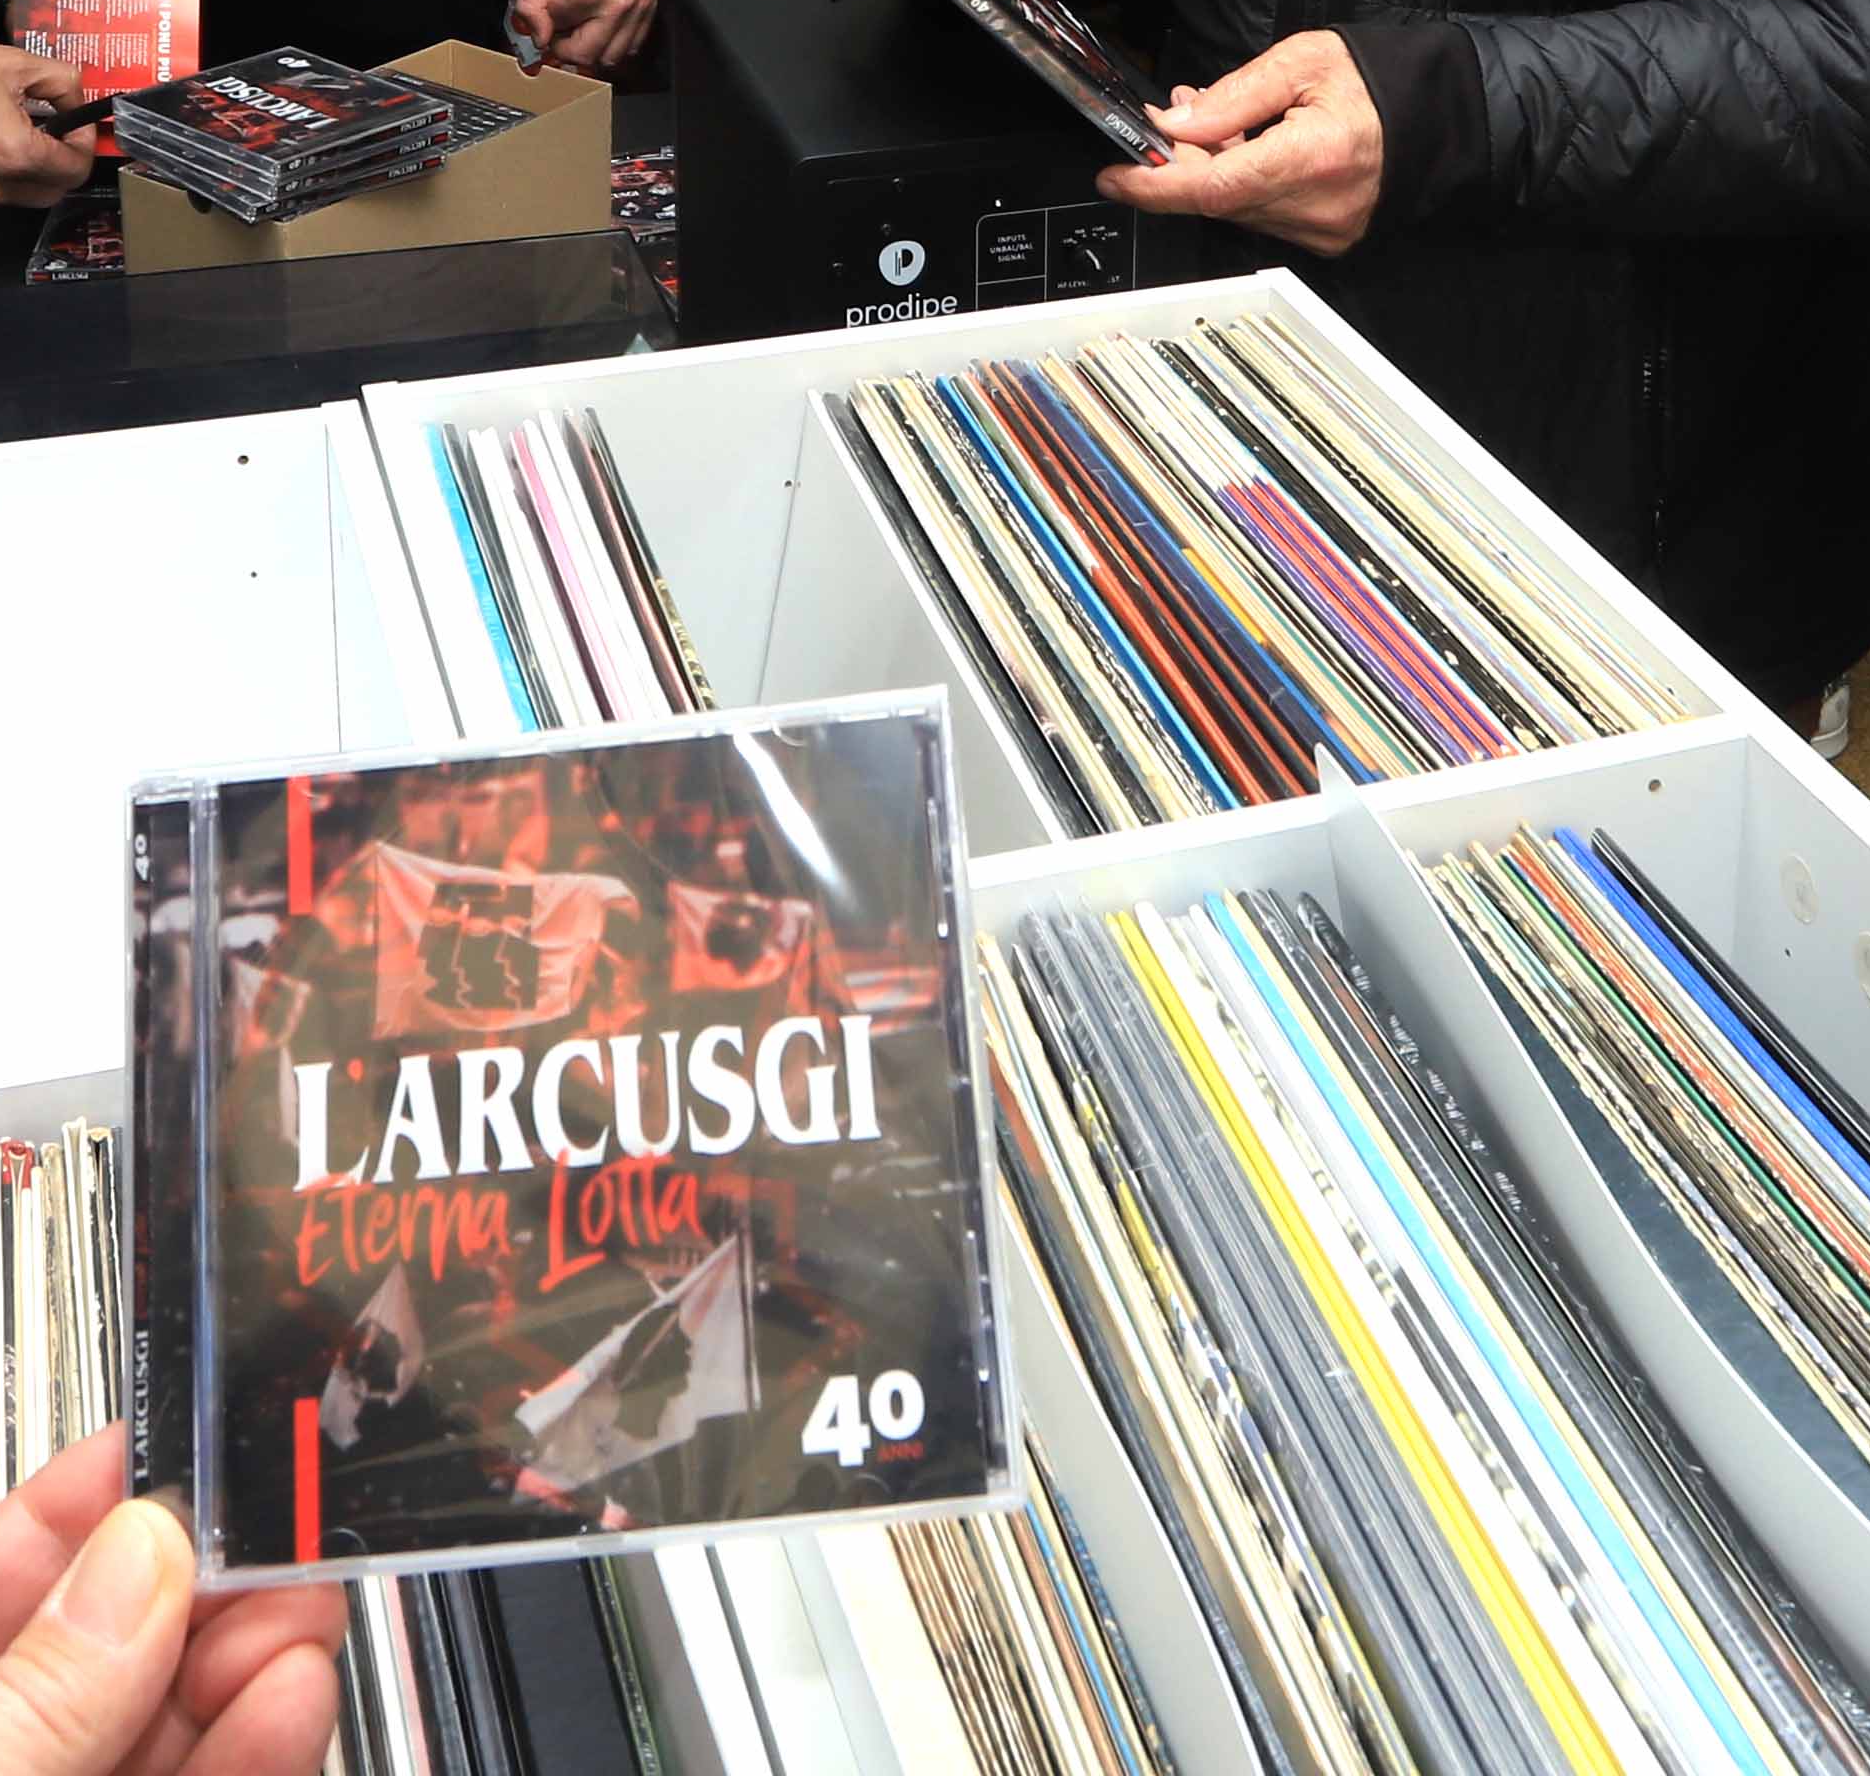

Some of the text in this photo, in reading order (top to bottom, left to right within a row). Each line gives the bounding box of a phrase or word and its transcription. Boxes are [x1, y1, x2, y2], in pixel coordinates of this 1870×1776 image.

[157, 10, 172, 53] PONU
[275, 53, 312, 71] 40
[990, 242, 1034, 255] UNBAL/BAL
[997, 233, 1026, 245] INPUTS
[998, 252, 1025, 264] SIGNAL
[846, 291, 959, 329] prodipe
[133, 833, 150, 883] 40
[293, 1172, 512, 1286] Eterna
[539, 1147, 707, 1292] Lotta
[800, 1369, 926, 1467] 40
